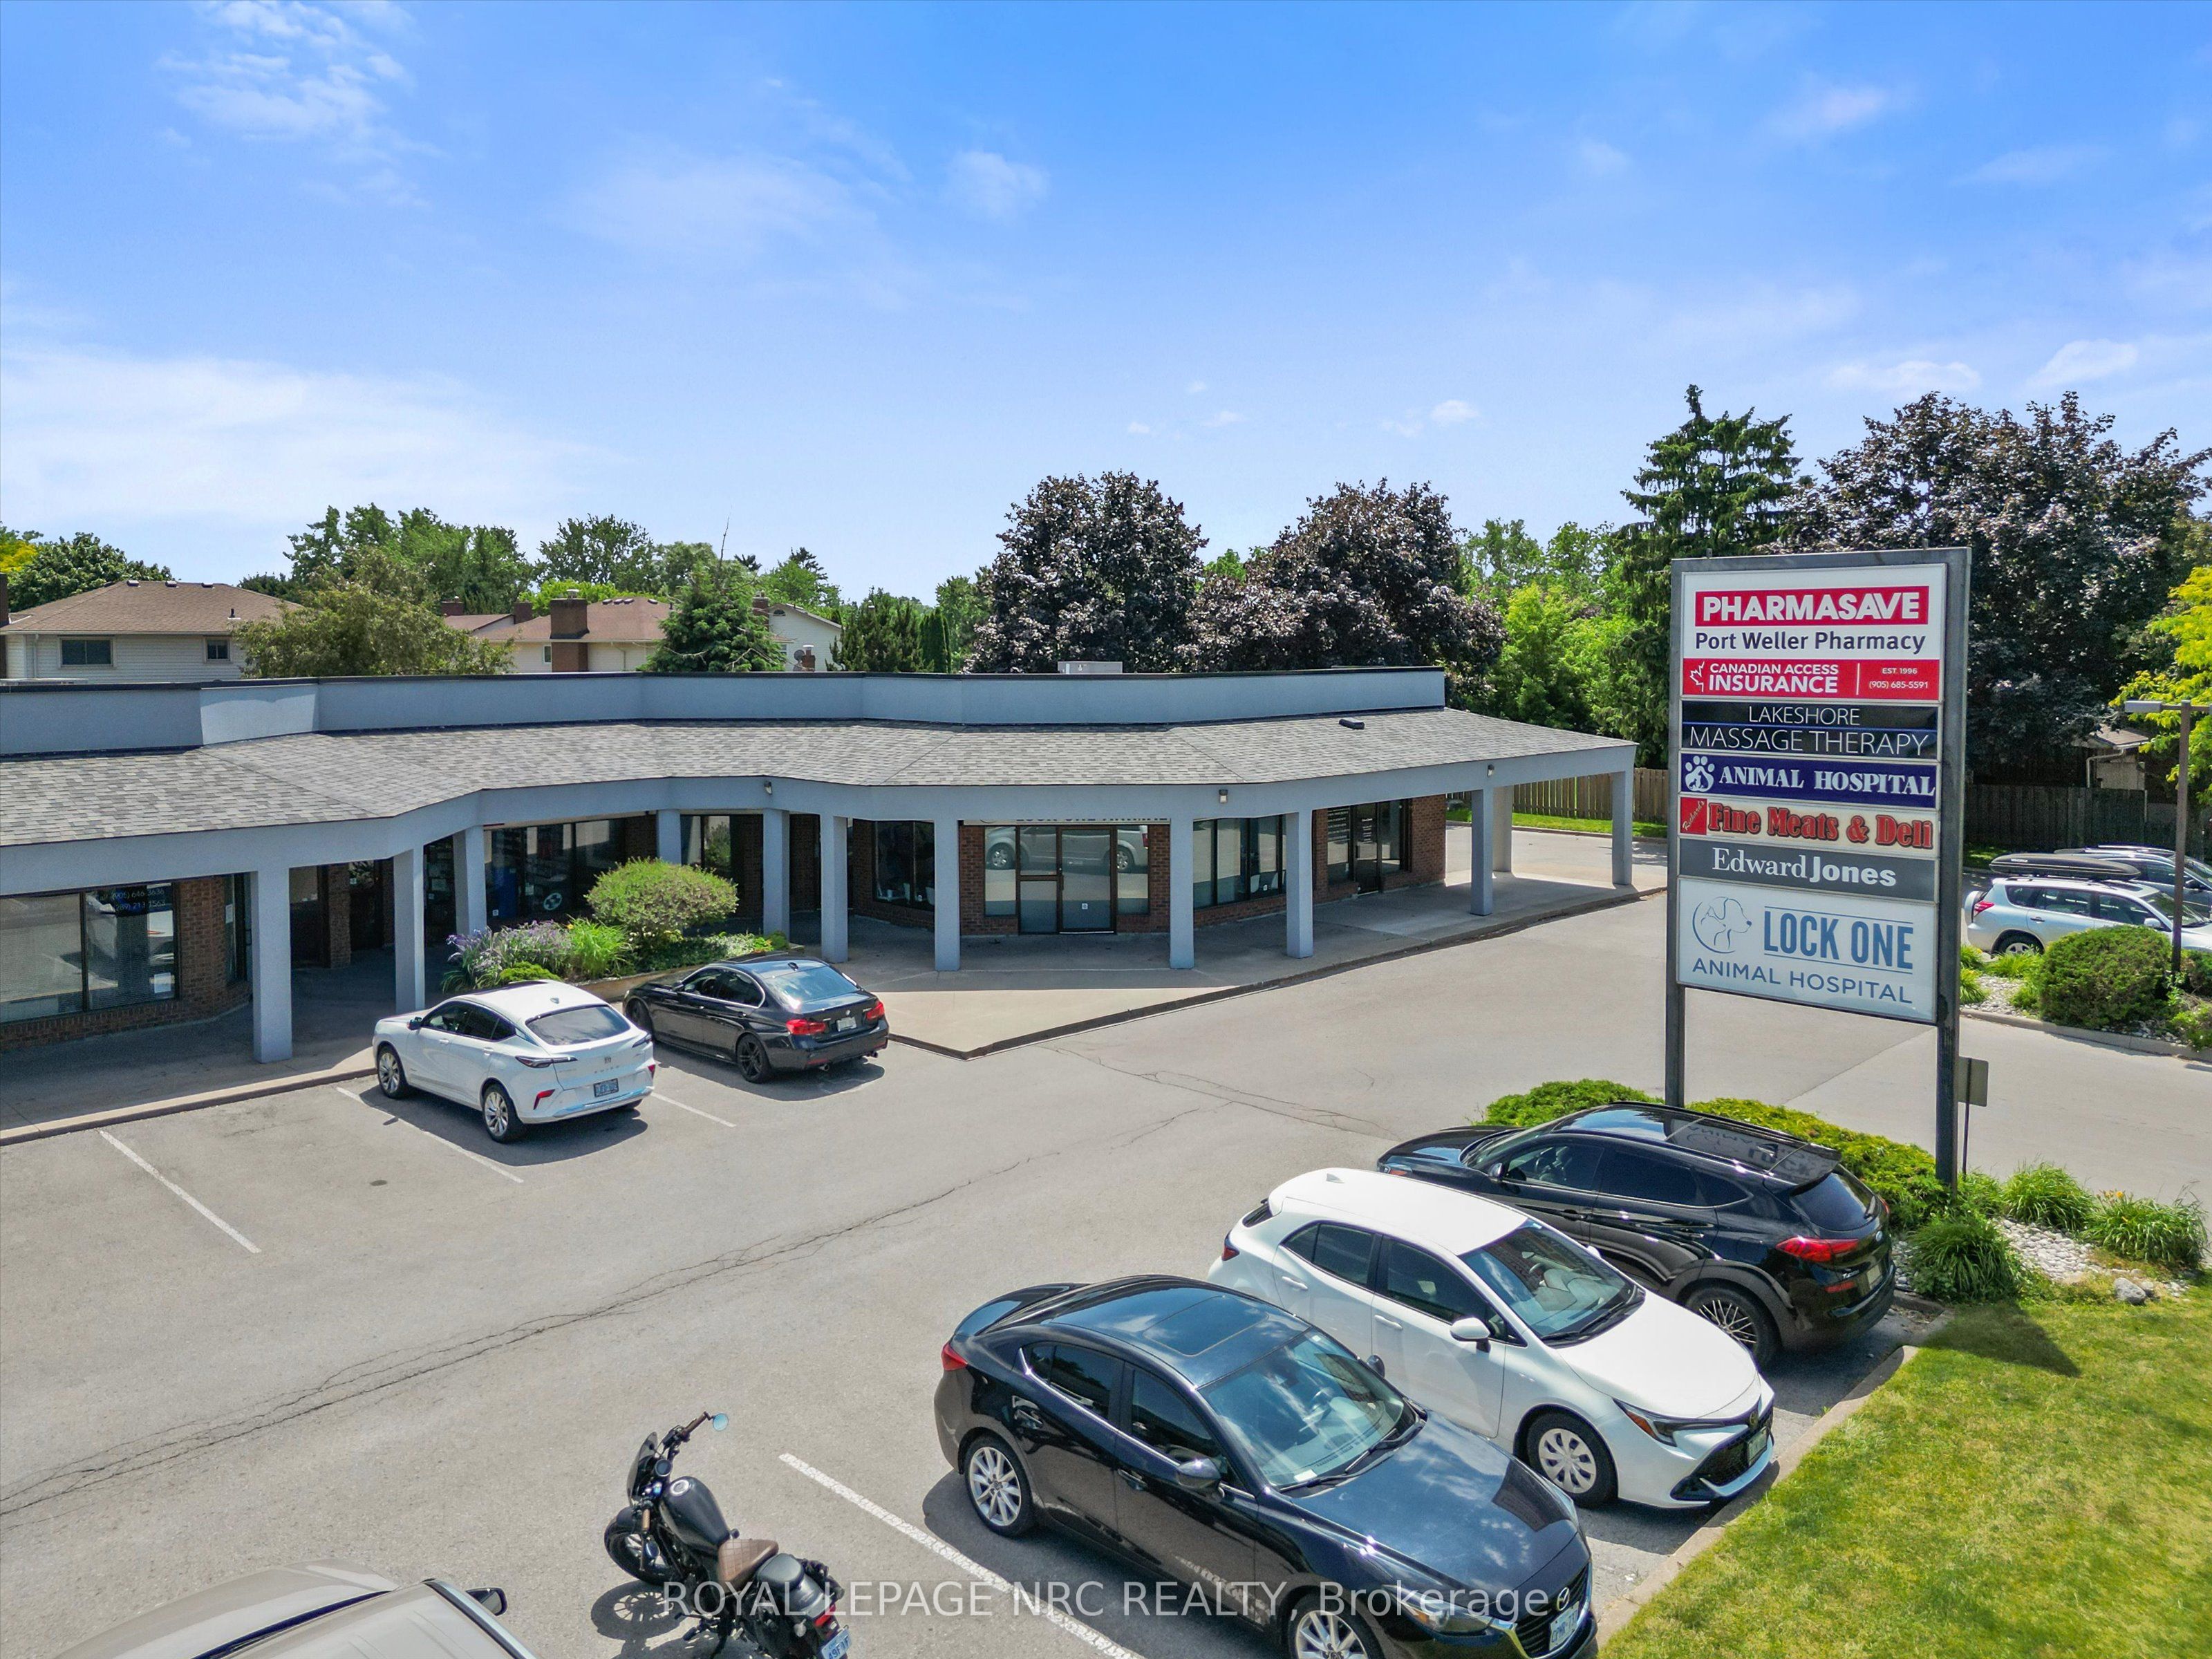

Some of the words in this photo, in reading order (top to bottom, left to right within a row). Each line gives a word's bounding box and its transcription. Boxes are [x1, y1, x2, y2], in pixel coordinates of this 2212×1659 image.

[1703, 592, 1920, 621] PHARMASAVE
[1696, 632, 1736, 650] Port
[1743, 632, 1808, 650] Weller
[1815, 632, 1926, 655] Pharmacy
[1709, 663, 1781, 674] CANADIAN
[1784, 664, 1839, 675] ACCESS
[1709, 674, 1838, 693] INSURANCE
[1869, 680, 1889, 689] (905)
[1891, 681, 1929, 689] 685-5591
[1749, 706, 1860, 726] LAKESHORE
[1690, 726, 1803, 751] MASSAGE
[1808, 731, 1929, 756] THERAPY
[1719, 766, 1804, 788] ANIMAL
[1814, 770, 1936, 796] HOSPITAL
[1683, 800, 1705, 831] Richard's
[1708, 802, 1761, 834] Fine
[1767, 807, 1839, 841] Meats
[1846, 815, 1869, 844] &
[1875, 814, 1934, 850] Deli
[1764, 910, 1839, 960] LOCK
[1851, 920, 1913, 969] ONE
[1692, 958, 1781, 985] ANIMAL
[1790, 971, 1913, 1004] HOSPITAL
